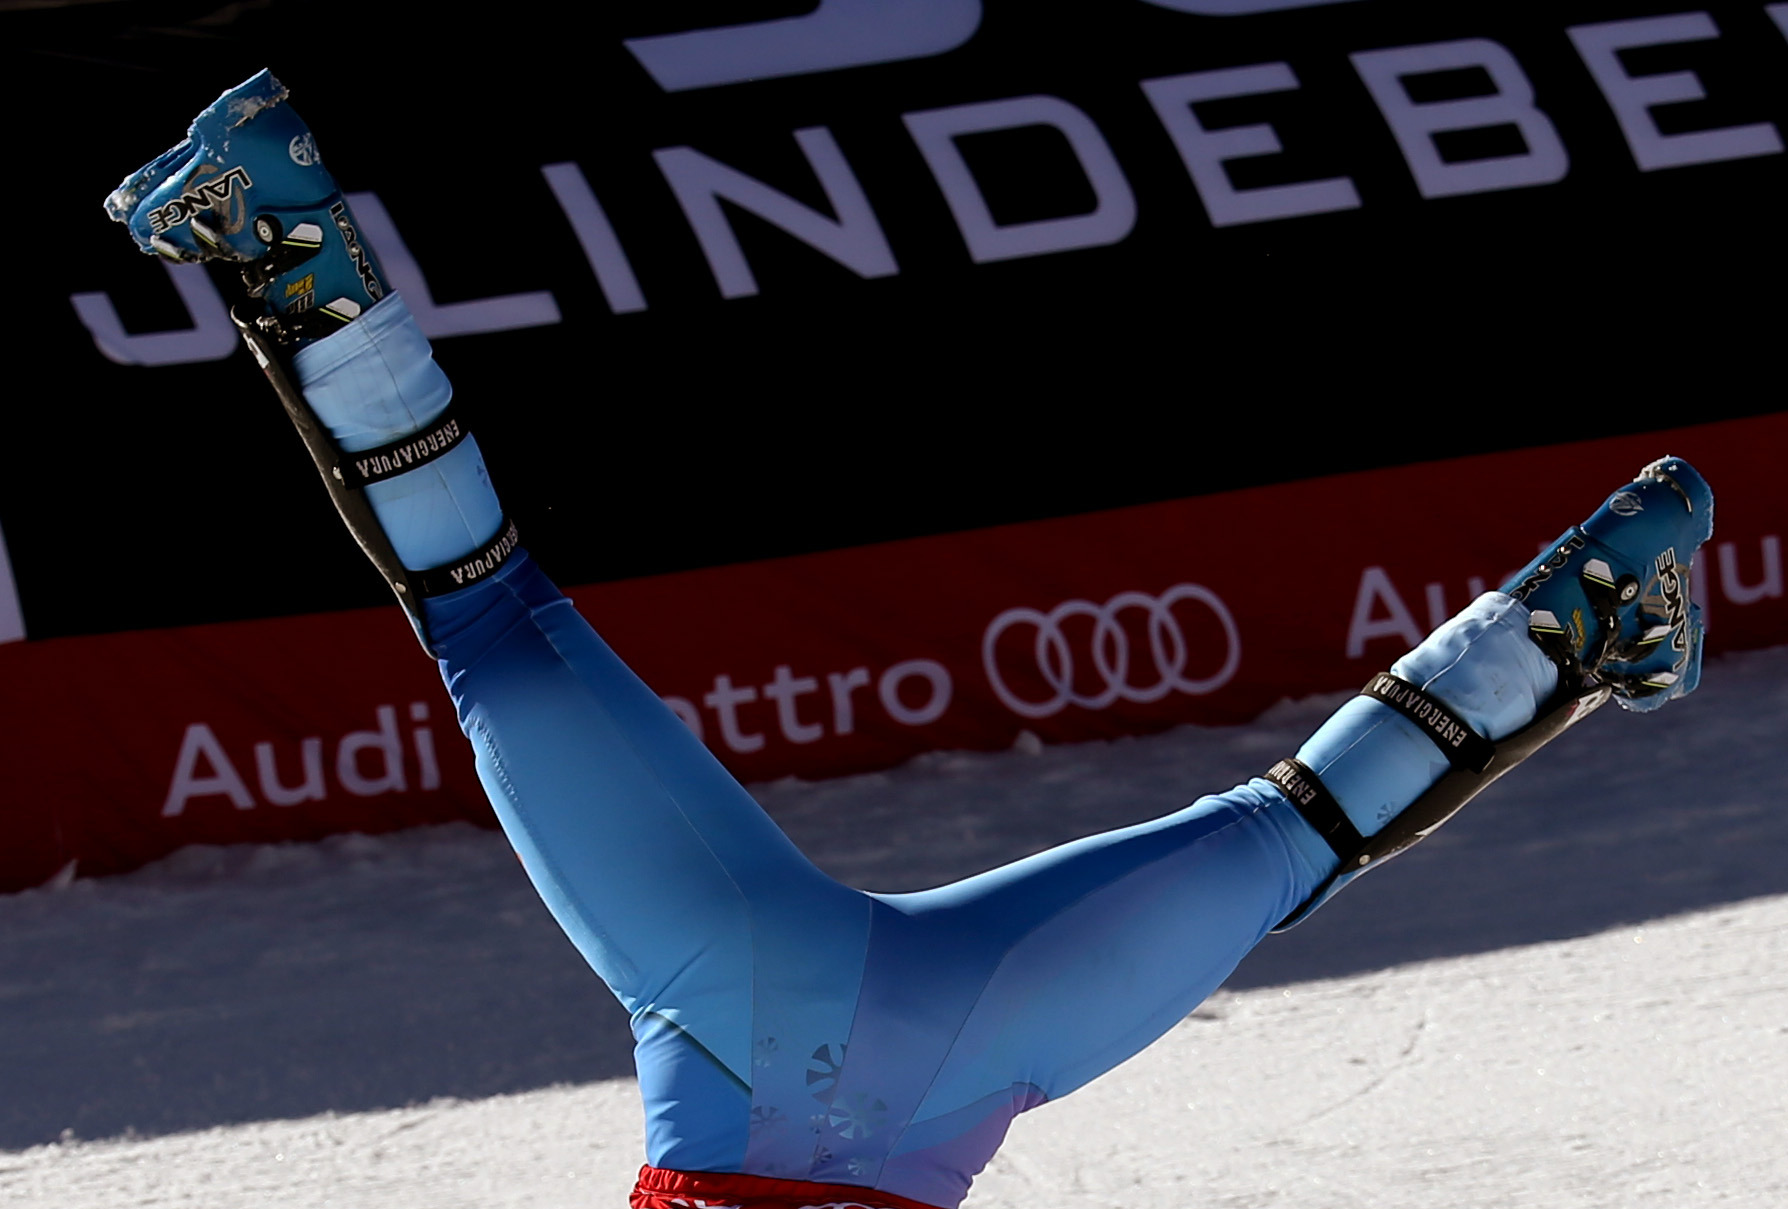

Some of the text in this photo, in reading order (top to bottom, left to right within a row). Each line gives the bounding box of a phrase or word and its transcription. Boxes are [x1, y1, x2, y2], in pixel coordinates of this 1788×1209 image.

[147, 165, 253, 235] LANGE
[329, 201, 384, 302] LANG
[356, 419, 460, 478] ENERGIAPURA
[1509, 535, 1585, 602] LANG
[1372, 676, 1468, 747] ENERGIAPURA
[161, 702, 441, 817] Audi
